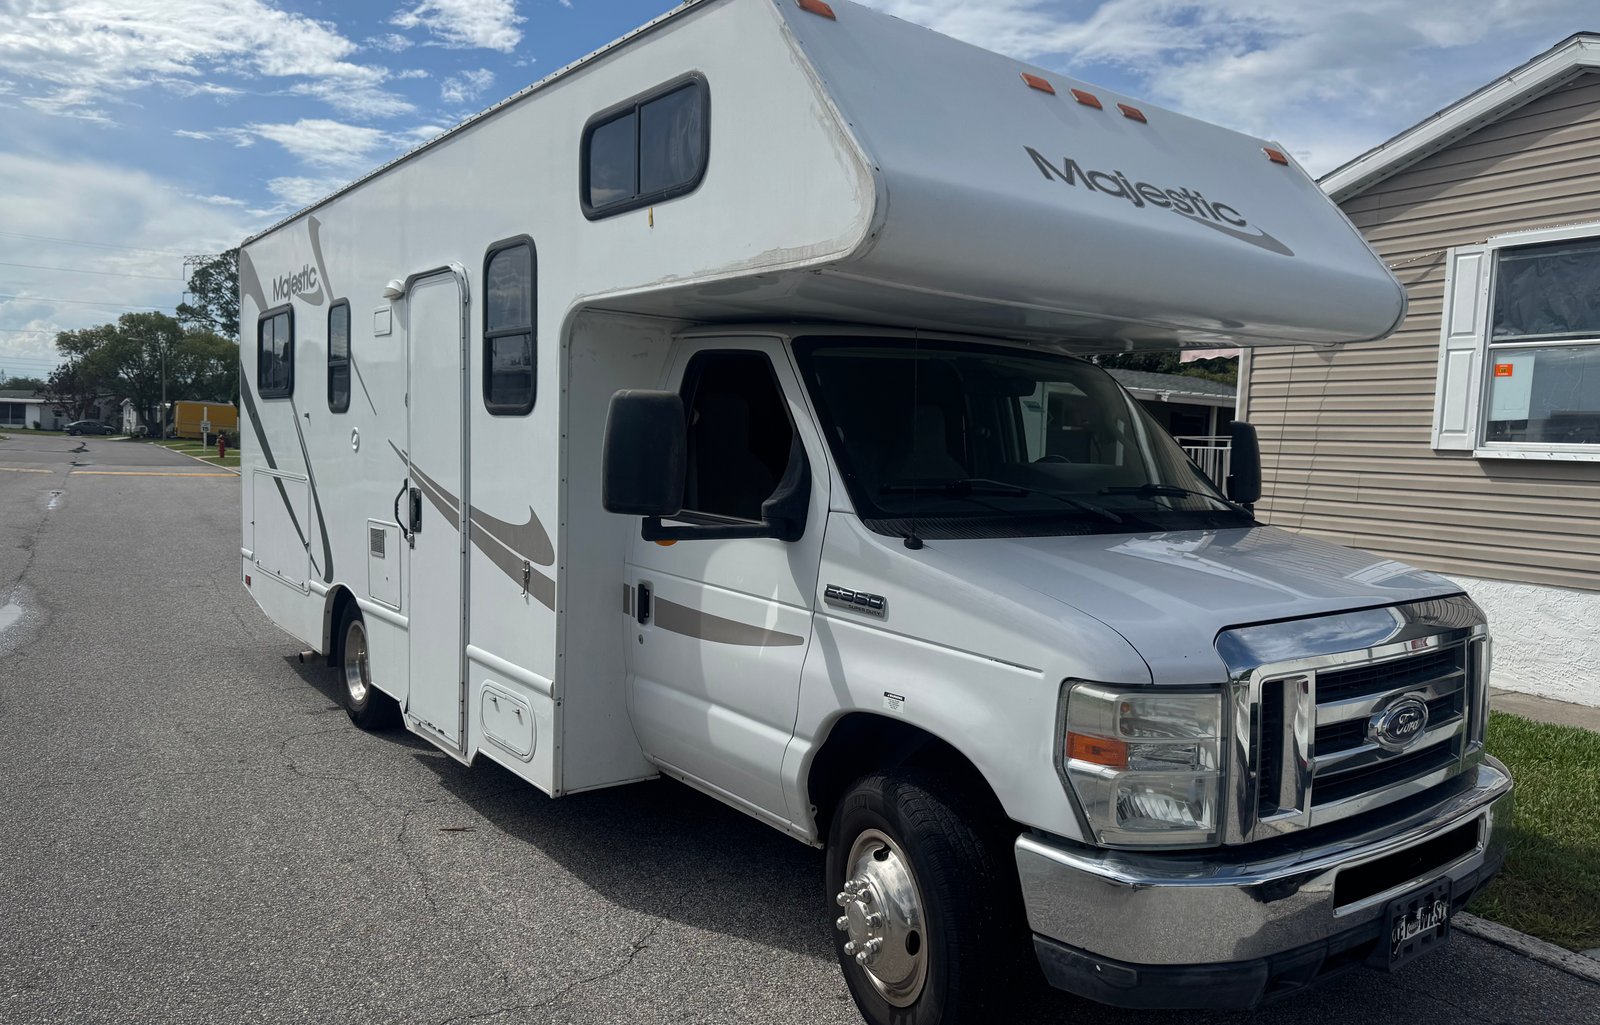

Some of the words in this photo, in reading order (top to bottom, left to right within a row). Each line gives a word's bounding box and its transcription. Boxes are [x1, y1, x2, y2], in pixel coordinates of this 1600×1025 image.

[1023, 145, 1247, 228] Majestic
[272, 264, 317, 302] Majestic
[848, 603, 866, 613] SUPER
[1396, 712, 1420, 735] Ford
